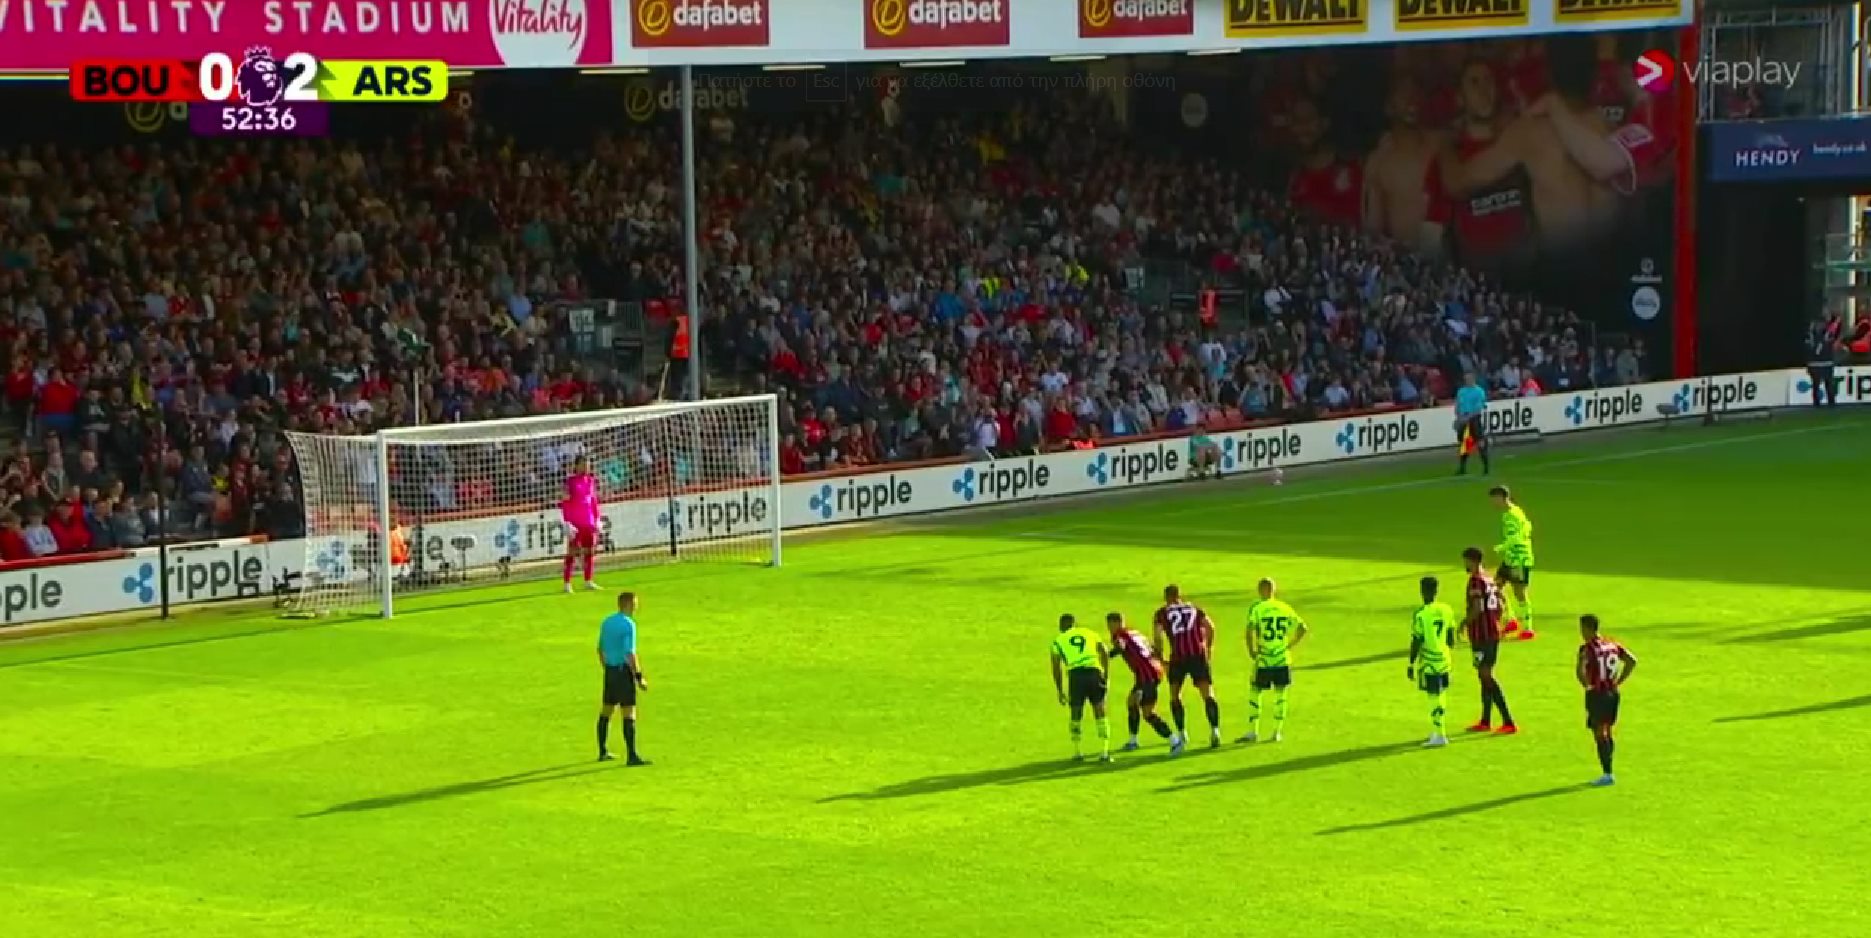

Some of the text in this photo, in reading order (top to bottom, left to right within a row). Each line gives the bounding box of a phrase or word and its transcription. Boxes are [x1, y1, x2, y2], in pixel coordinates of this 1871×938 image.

[263, 0, 470, 33] STADIUM
[495, 0, 583, 49] Vitality
[673, 0, 763, 31] dafabet
[909, 0, 1003, 29] dafabet
[658, 80, 748, 113] daabet
[1735, 150, 1801, 167] HENDY
[1584, 387, 1643, 424] ripple
[1692, 375, 1758, 413] ripple
[1236, 428, 1301, 467] ripple
[1357, 413, 1420, 451] ripple
[978, 458, 1050, 498] ripple
[1110, 443, 1180, 483] ripple
[687, 490, 767, 535] ripple
[836, 474, 913, 518] ripple
[0, 572, 63, 621] ple
[1167, 608, 1197, 635] 27
[1261, 616, 1289, 642] 35
[1432, 619, 1444, 638] 7
[1070, 634, 1087, 655] 9
[1597, 653, 1618, 680] 19
